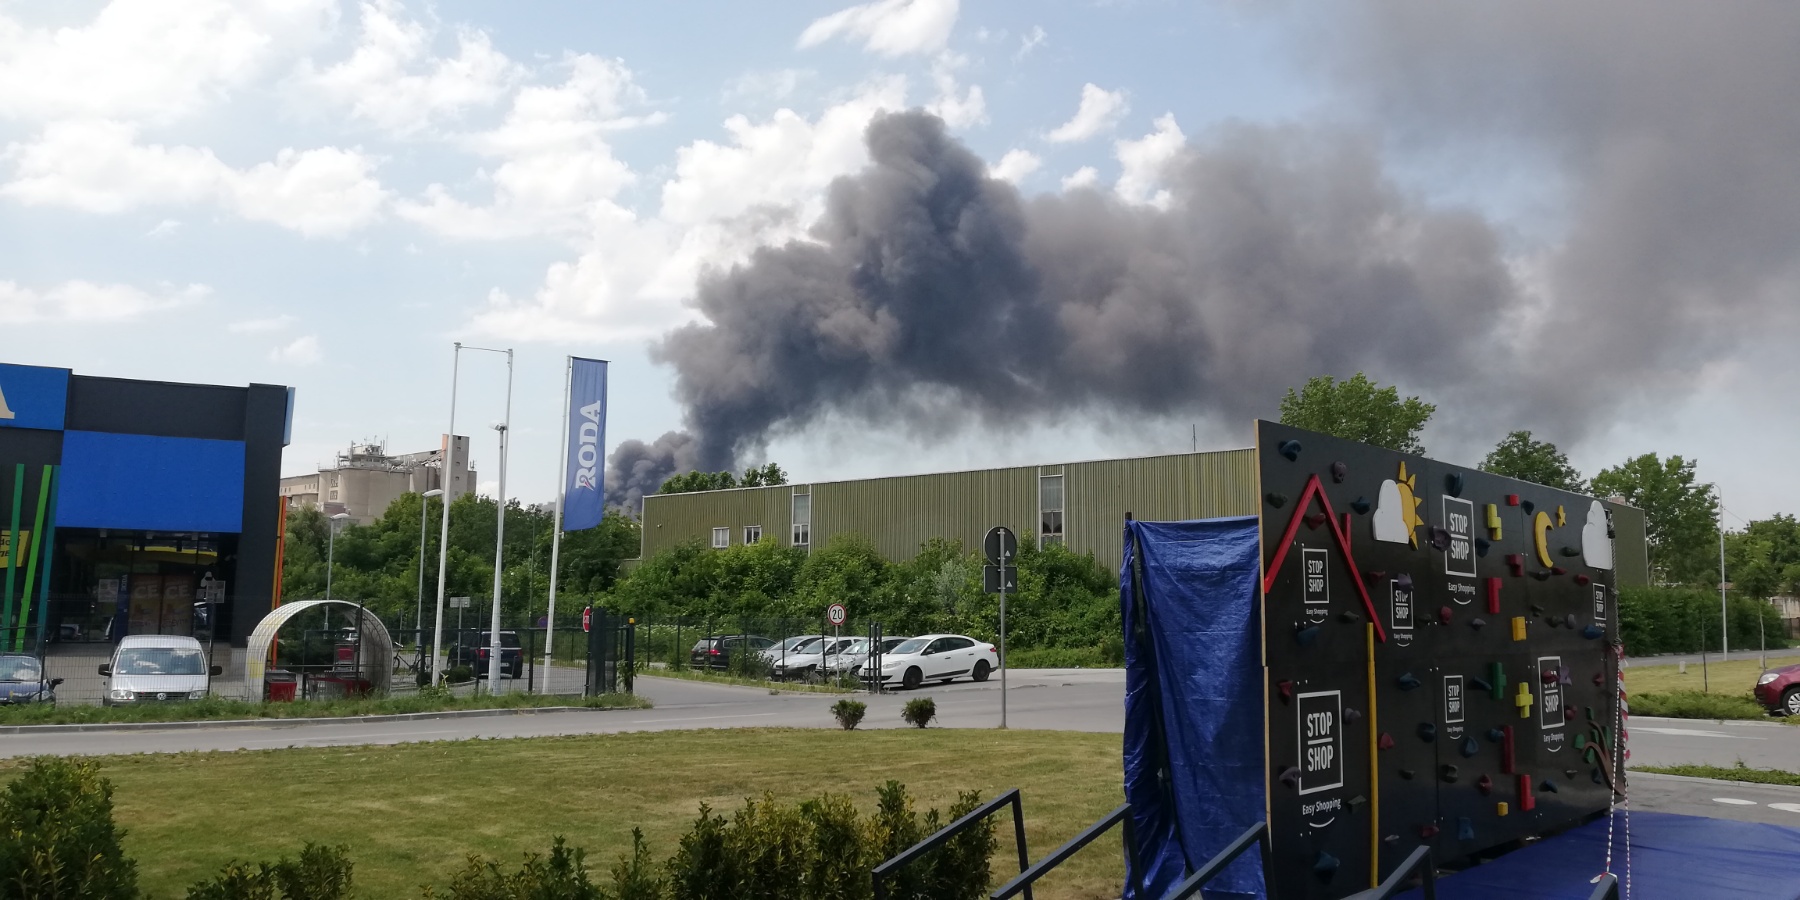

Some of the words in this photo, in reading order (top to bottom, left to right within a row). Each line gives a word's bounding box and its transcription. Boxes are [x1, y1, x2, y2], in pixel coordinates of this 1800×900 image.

[575, 400, 601, 491] RODA
[1450, 512, 1468, 534] STOP
[1450, 540, 1470, 560] SHOP
[1308, 559, 1323, 574] STOP
[1308, 578, 1324, 593] SHOP
[1448, 583, 1458, 594] Easy
[1458, 583, 1475, 596] Shopping
[832, 608, 843, 620] 20
[1395, 607, 1409, 619] SHOP
[1545, 694, 1559, 713] SHOP
[1307, 711, 1333, 738] STOP
[1307, 745, 1334, 772] SHOP
[1302, 803, 1315, 816] Easy
[1315, 798, 1342, 814] Shopping
